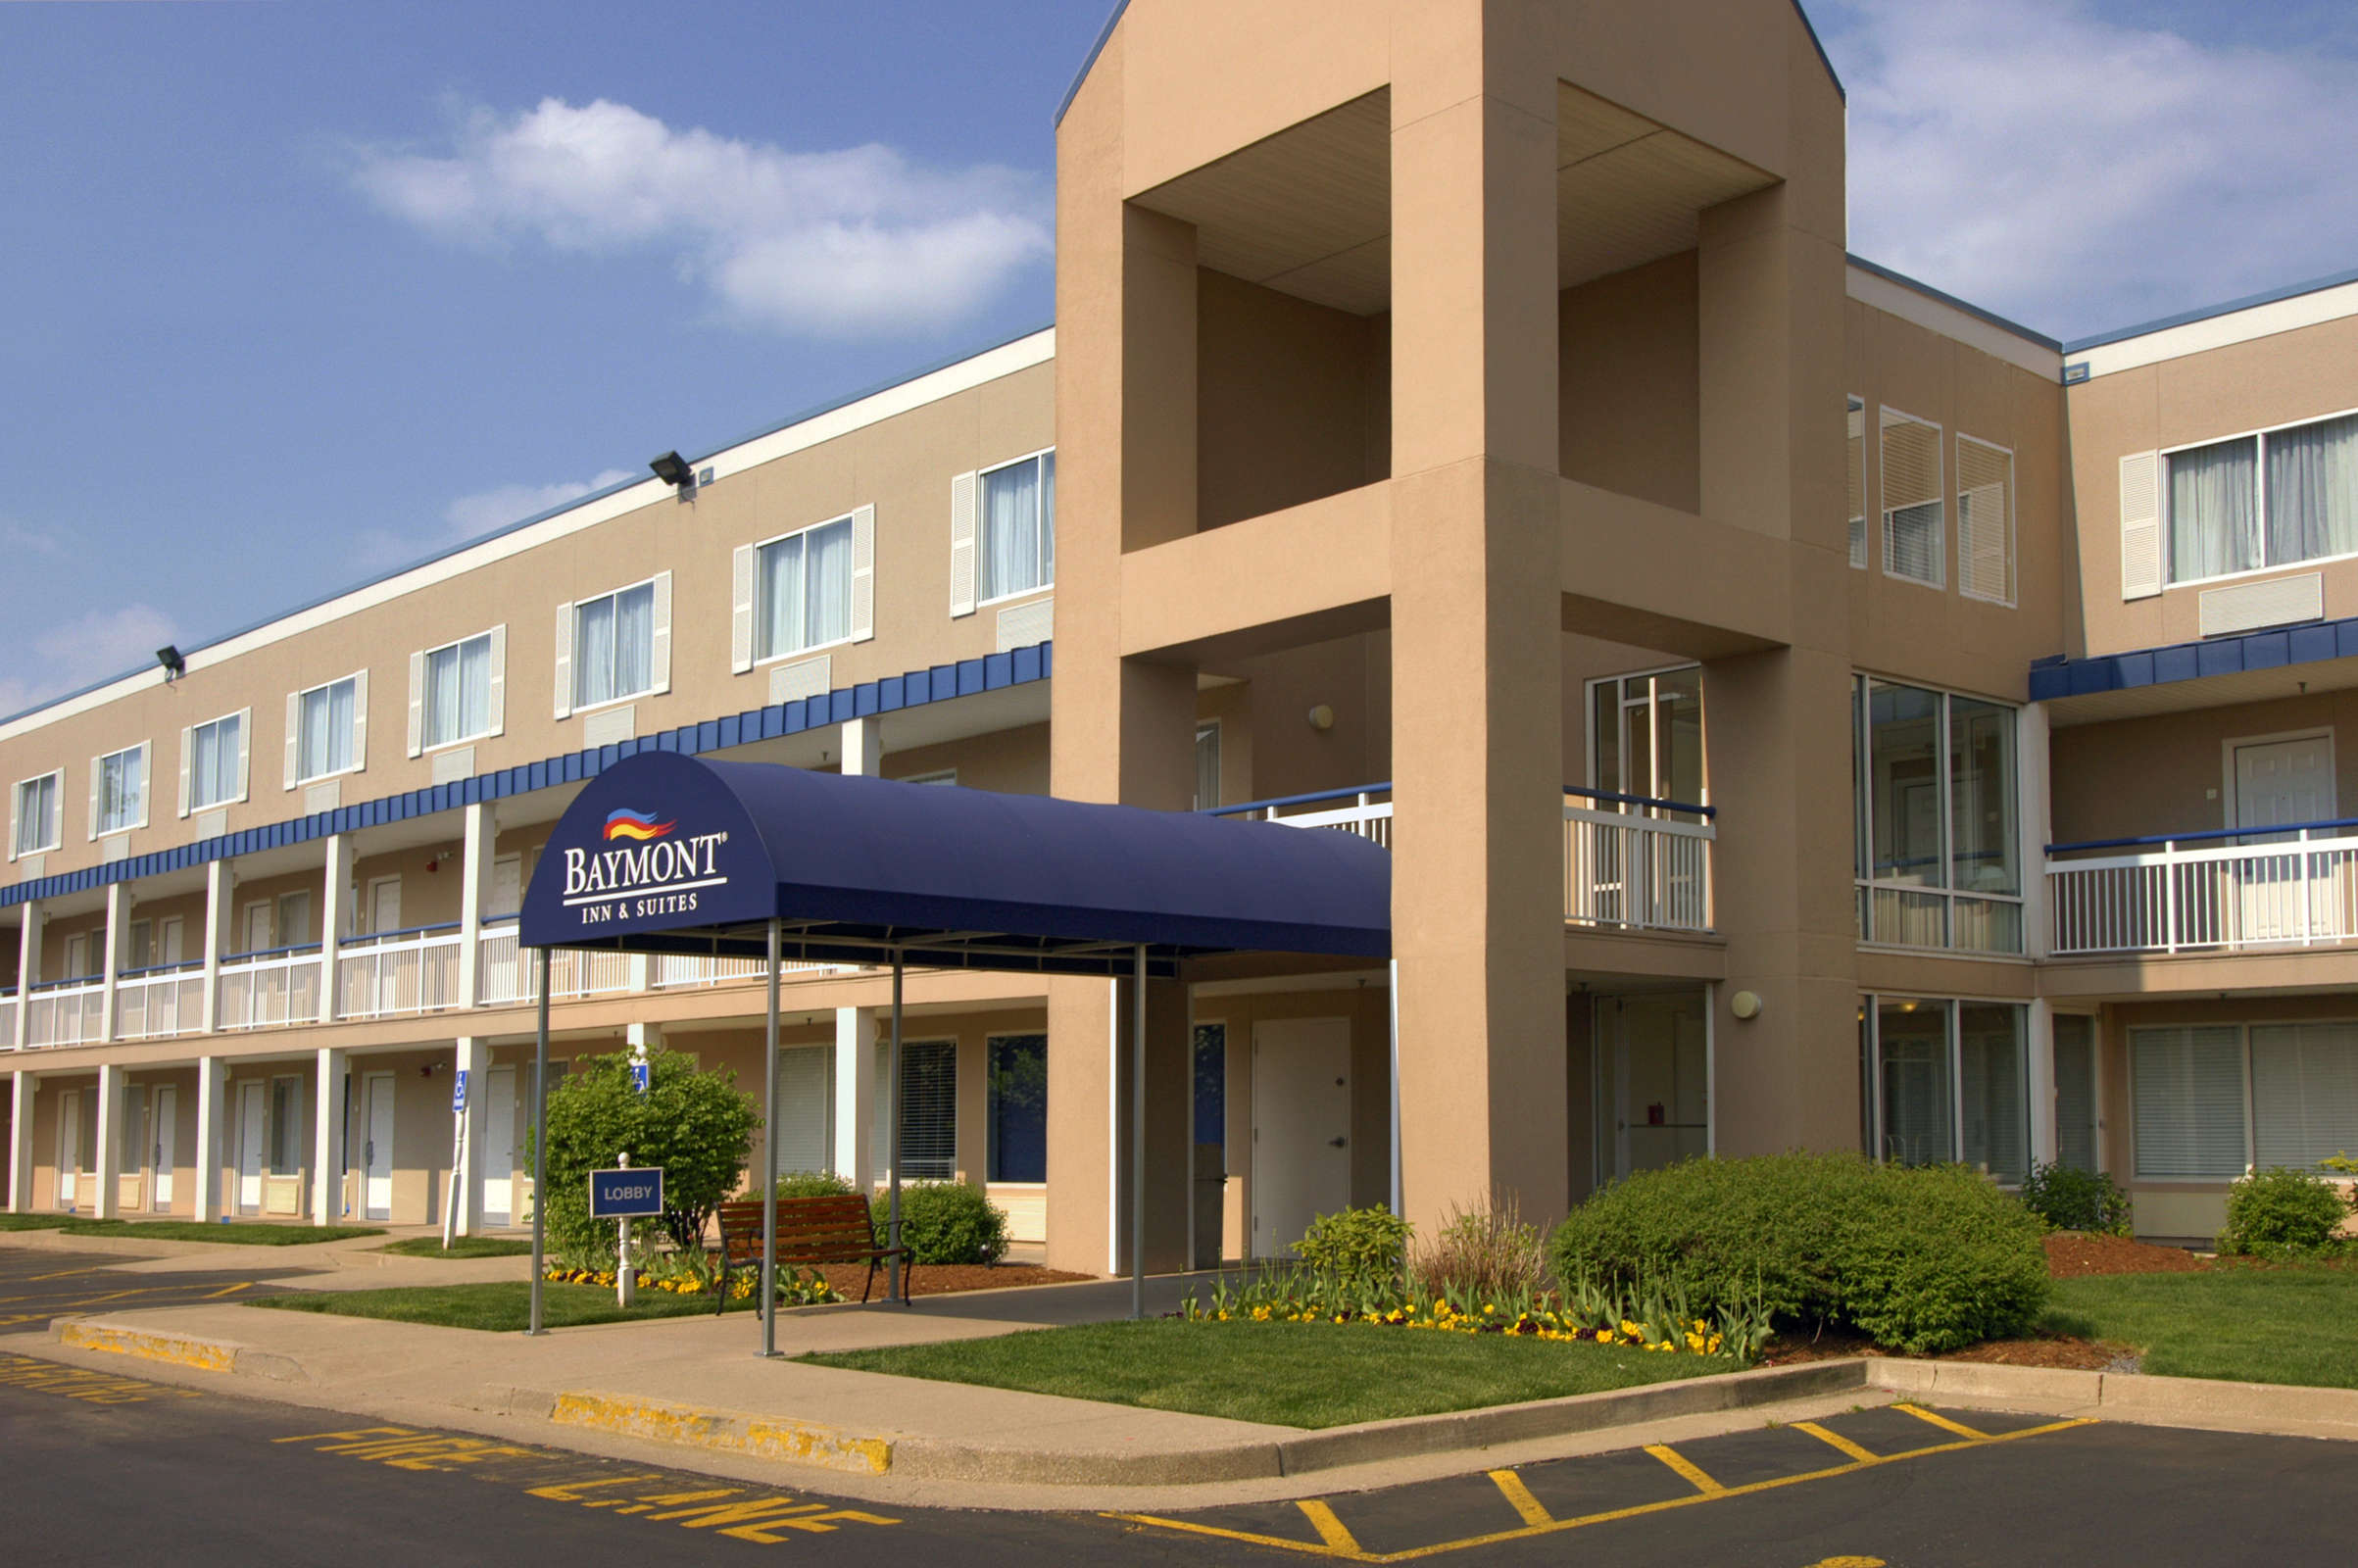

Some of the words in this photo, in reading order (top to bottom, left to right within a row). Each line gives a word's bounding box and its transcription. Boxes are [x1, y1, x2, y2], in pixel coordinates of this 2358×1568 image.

[581, 904, 612, 924] INN
[618, 902, 629, 919] &
[636, 893, 698, 917] SUITES
[604, 1185, 653, 1200] LOBBY
[270, 1426, 536, 1470] FIRE
[523, 1474, 904, 1544] LANE
